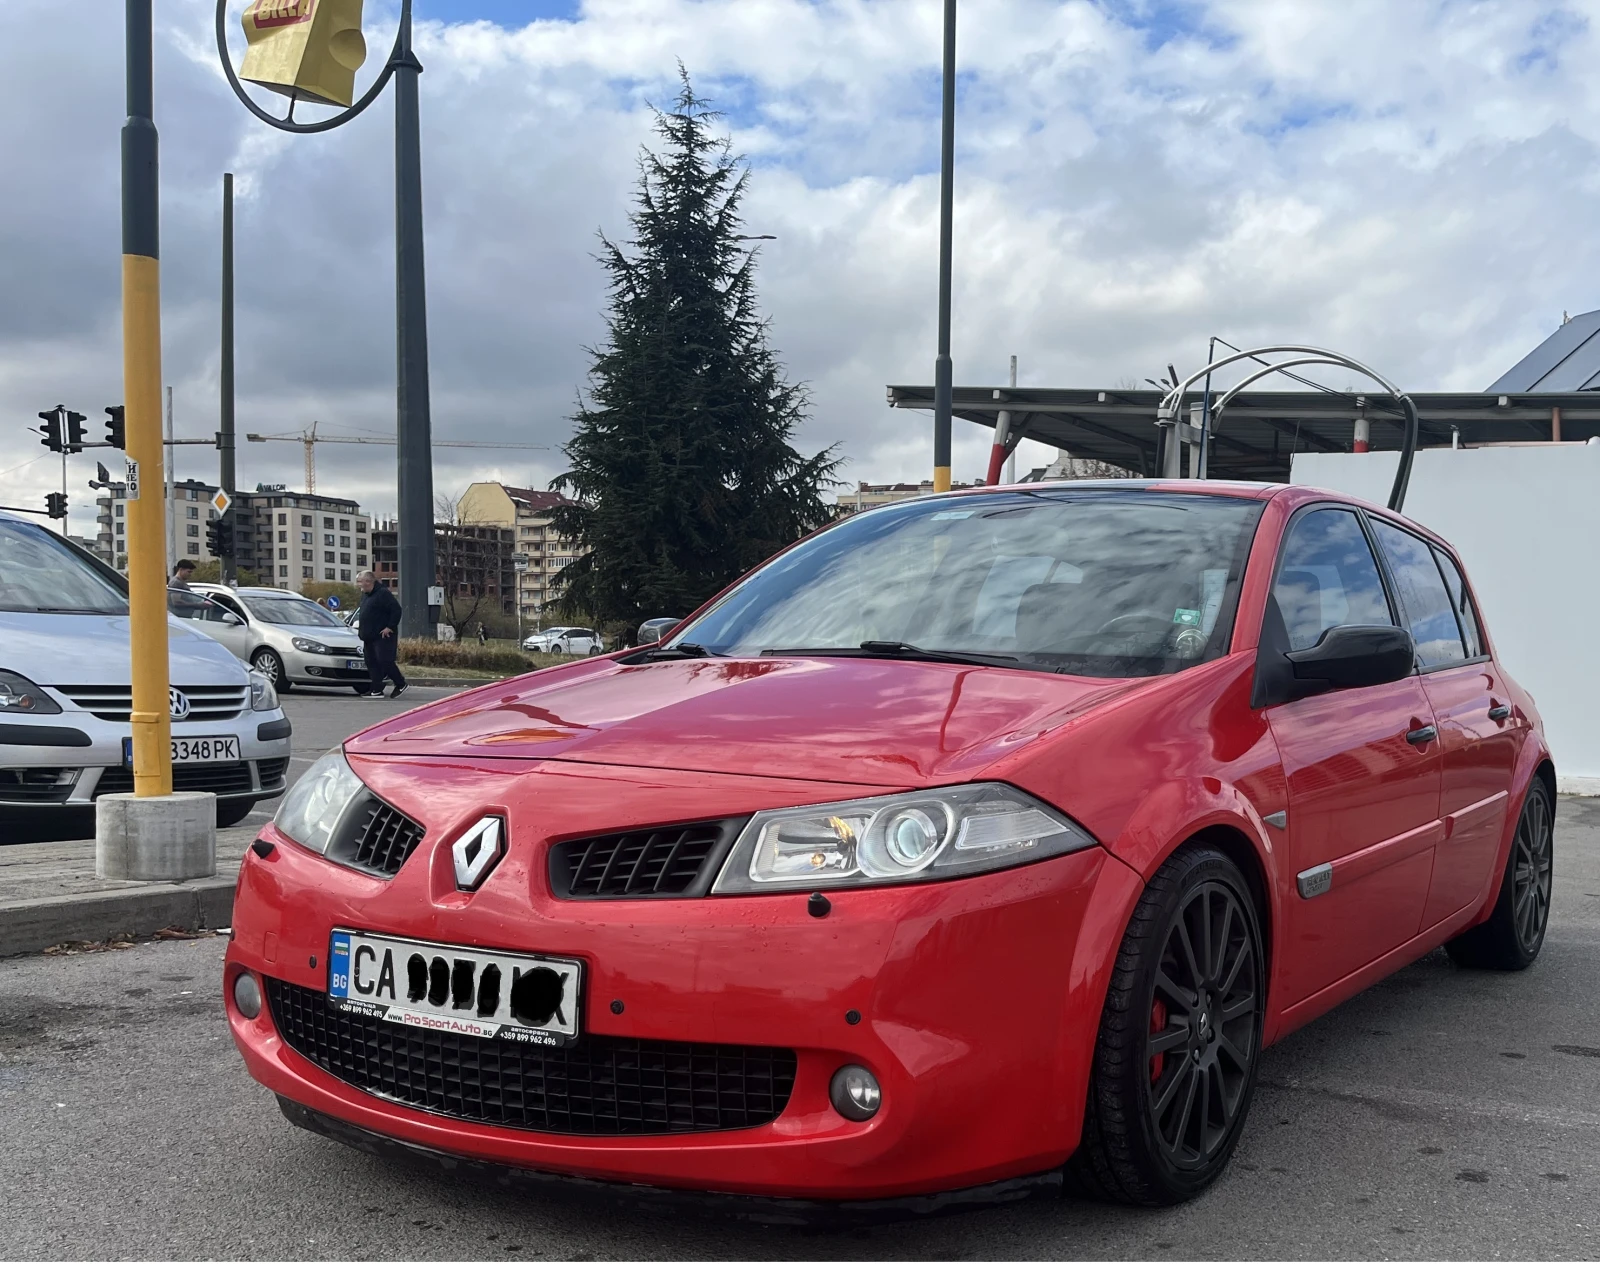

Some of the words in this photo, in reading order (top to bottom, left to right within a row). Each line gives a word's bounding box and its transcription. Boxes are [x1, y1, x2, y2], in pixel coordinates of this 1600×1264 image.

[214, 740, 236, 759] PK
[354, 944, 396, 1000] CA
[332, 973, 347, 989] BG
[363, 1008, 372, 1016] 962
[373, 1010, 383, 1018] 495
[500, 1031, 516, 1040] +359
[517, 1033, 529, 1042] 899
[530, 1036, 542, 1044] 962
[543, 1037, 557, 1046] 496
